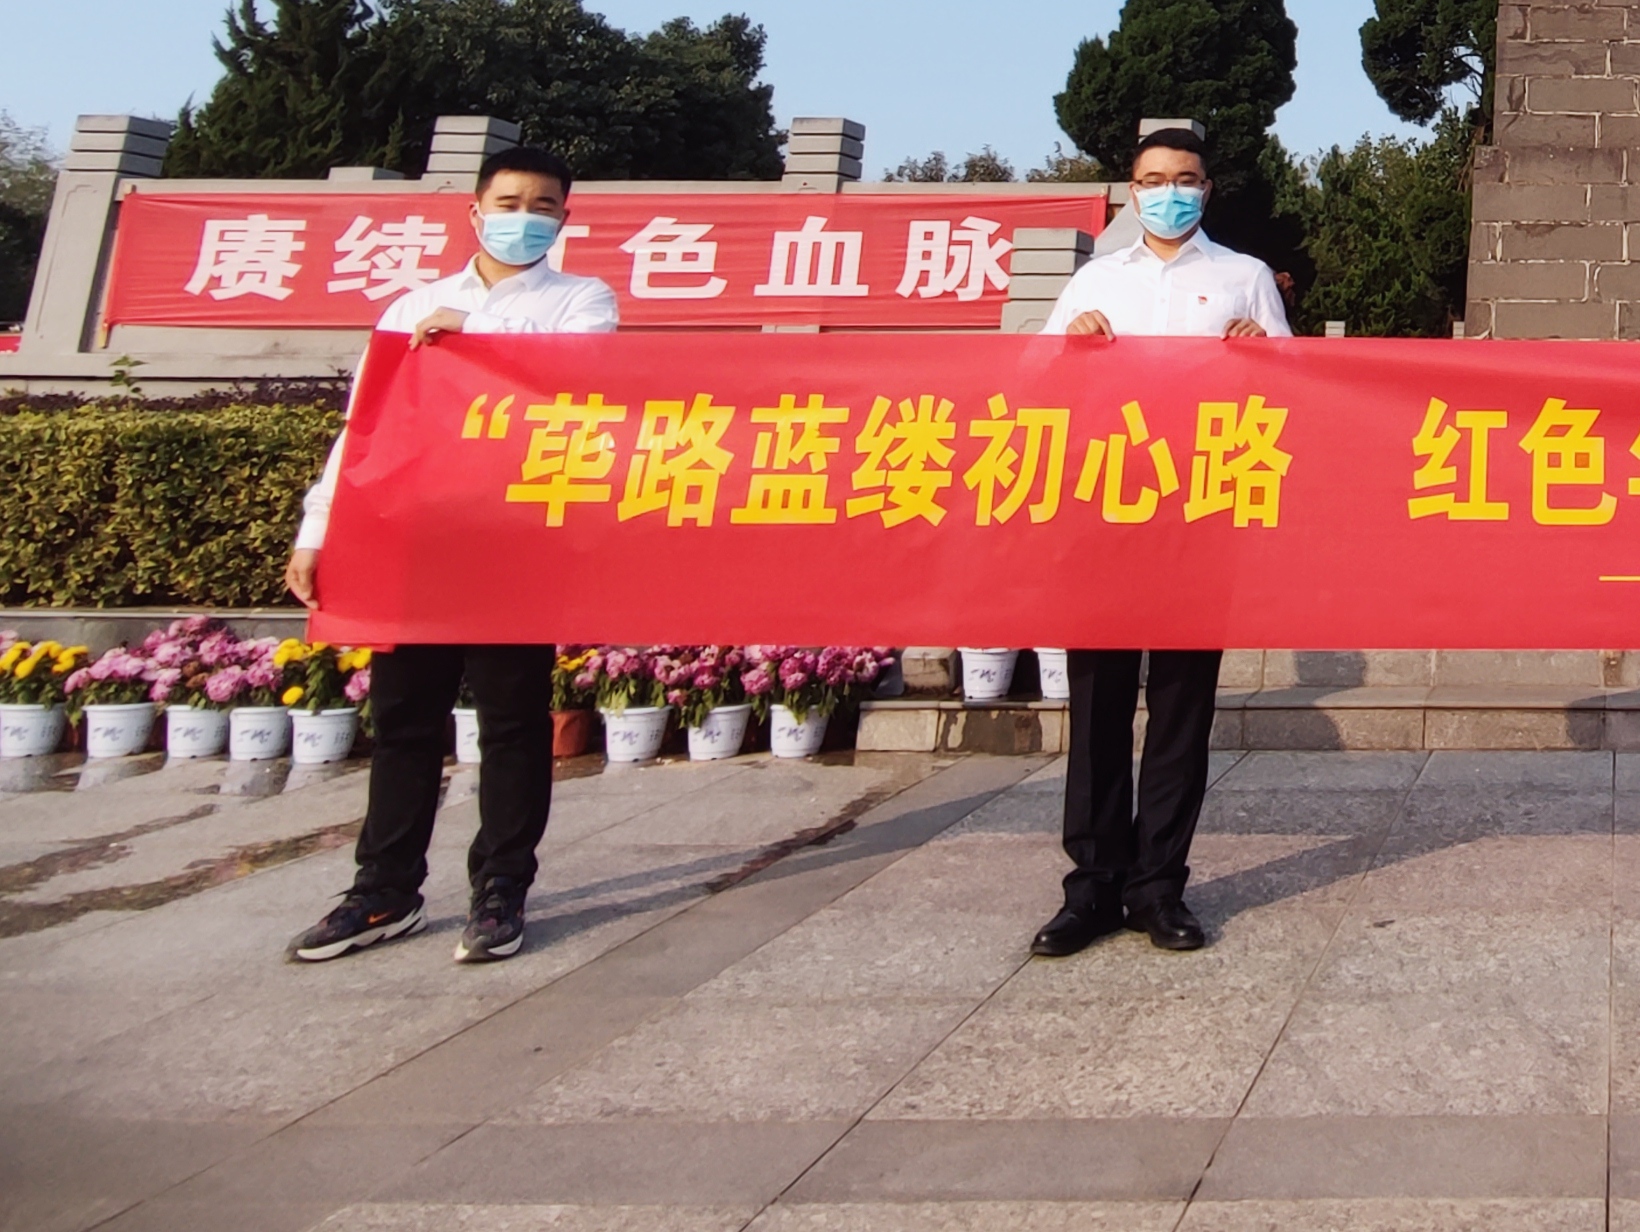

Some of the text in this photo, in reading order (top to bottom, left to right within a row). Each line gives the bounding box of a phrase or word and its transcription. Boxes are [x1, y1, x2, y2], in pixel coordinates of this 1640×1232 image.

[184, 213, 1013, 302] 赓续色血脉
